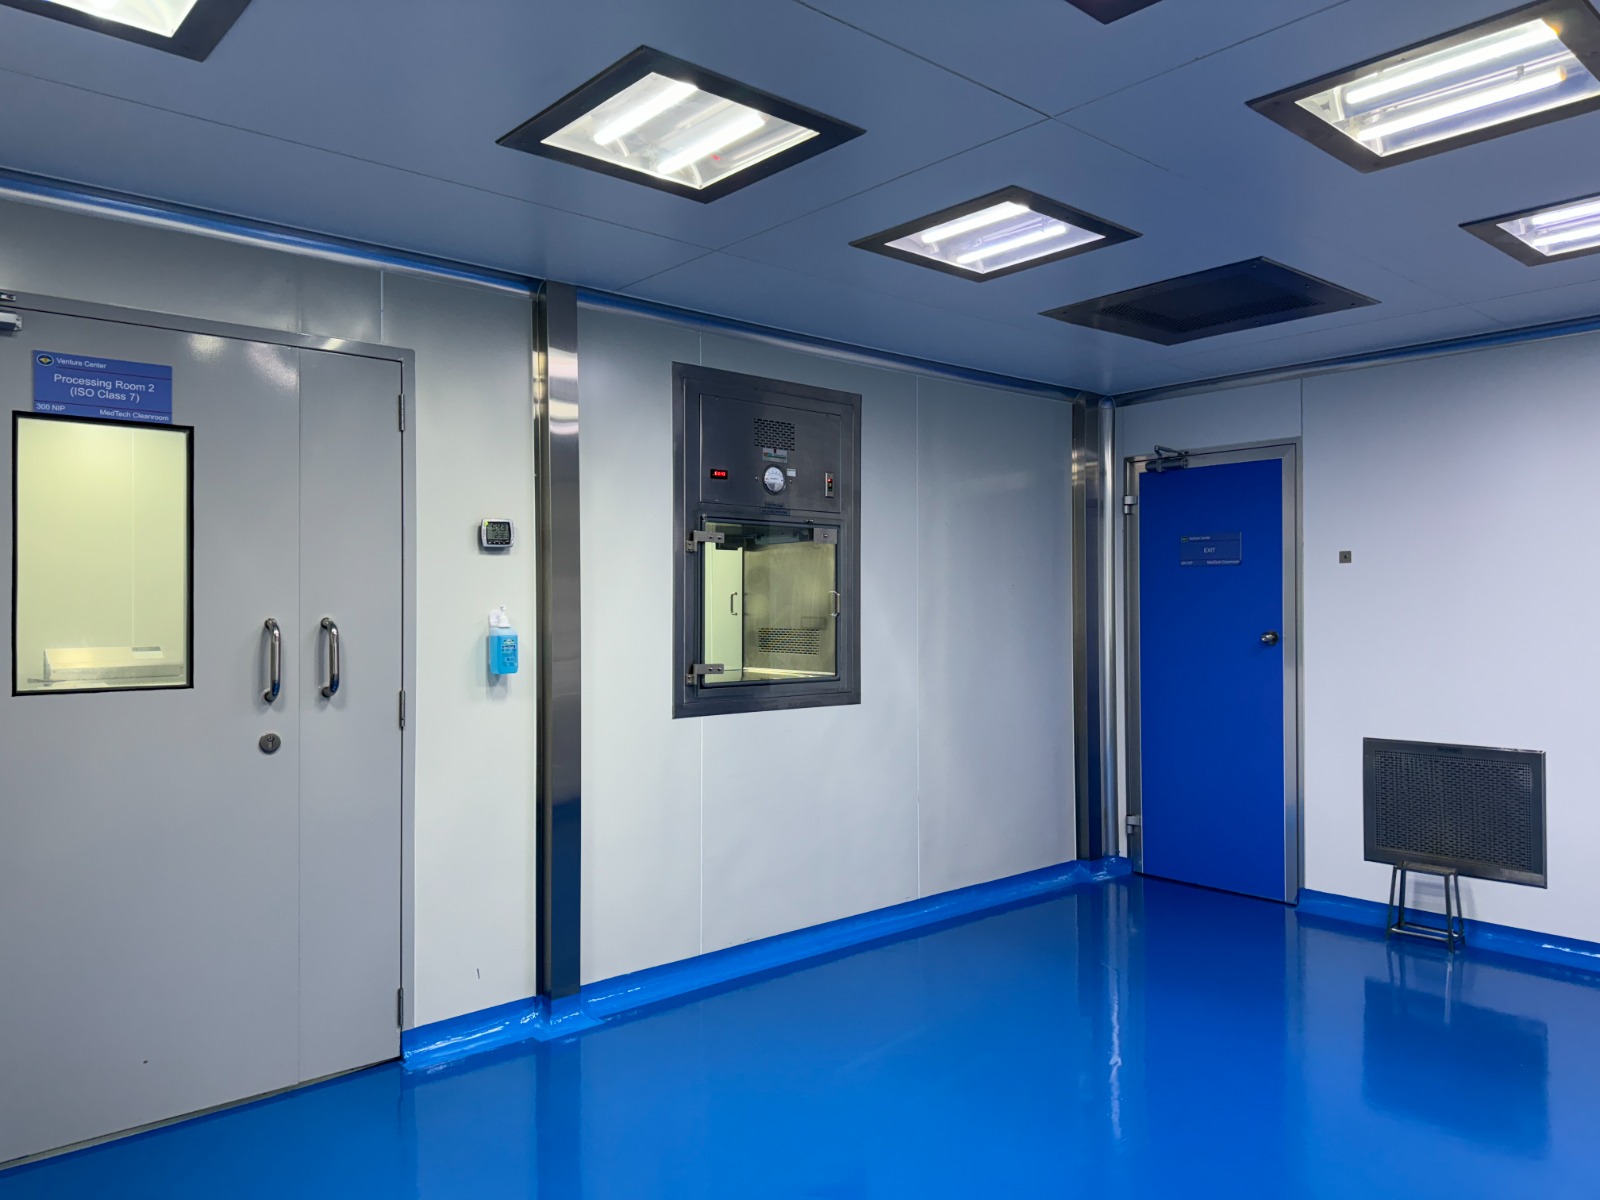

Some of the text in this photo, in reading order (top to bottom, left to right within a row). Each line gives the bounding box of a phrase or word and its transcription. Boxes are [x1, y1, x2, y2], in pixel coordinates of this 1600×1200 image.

[56, 357, 107, 369] Venture Center
[53, 373, 155, 392] Processing Room 2
[70, 387, 140, 403] (ISO Class 7)
[36, 403, 50, 411] 300
[100, 409, 169, 421] MedTech Cleanroom
